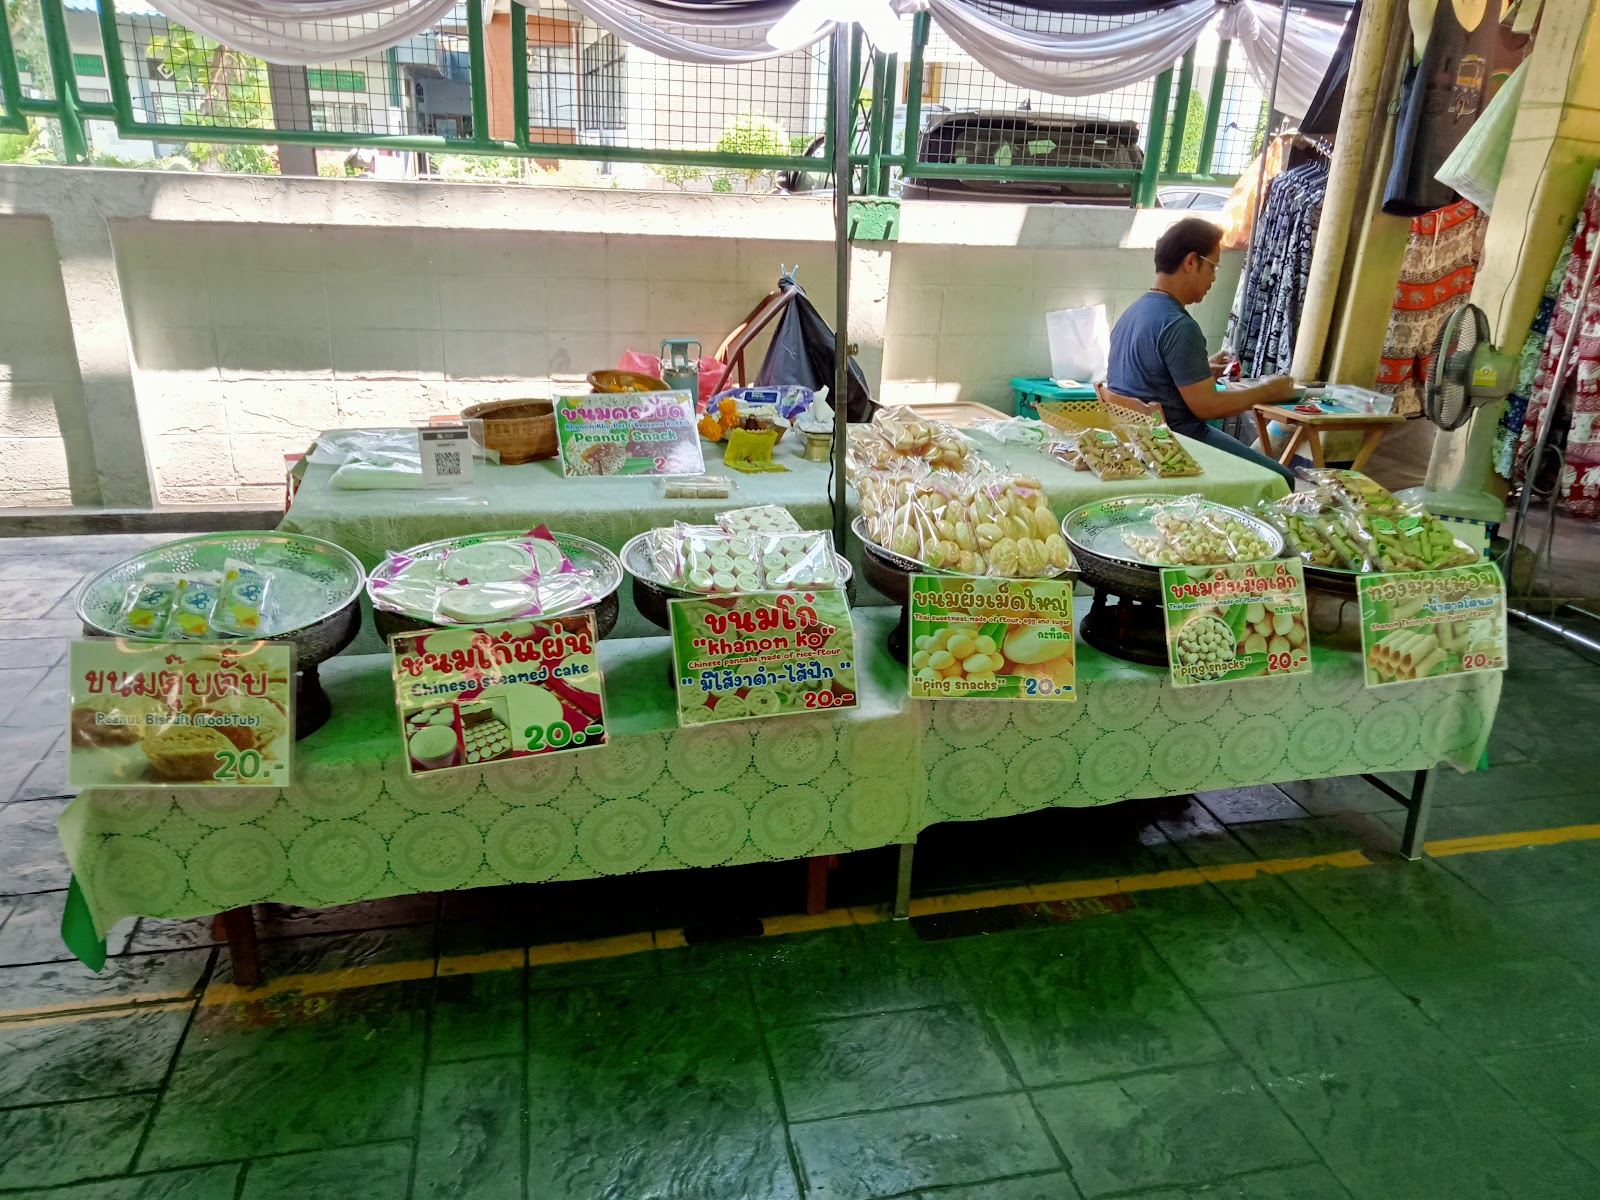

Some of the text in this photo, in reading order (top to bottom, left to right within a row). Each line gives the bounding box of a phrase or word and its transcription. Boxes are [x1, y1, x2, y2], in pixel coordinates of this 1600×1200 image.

[574, 429, 677, 443] Peanut Snack
[1171, 564, 1296, 599] ขนมผิงเม็ดเล็ก
[1366, 571, 1495, 602] ทองม้วนหอม
[914, 581, 1069, 618] ขนมผิงเม็ดใหญ่
[1184, 600, 1217, 609] sweetmeat
[704, 593, 819, 635] ขนมโก๋
[914, 613, 930, 621] Thai
[932, 615, 967, 623] sweetmeat
[970, 615, 986, 623] made
[999, 616, 1021, 625] flour,
[1024, 618, 1036, 626] egg
[1052, 619, 1071, 627] sugar
[1037, 627, 1070, 640] กะทิสด
[1371, 621, 1400, 631] Khanom
[1401, 618, 1424, 627] Thong
[401, 623, 593, 678] ขนมโก๋แผ่น
[688, 649, 841, 669] Chinese pancake made of rice-flour
[411, 662, 590, 697] Chinese steamed cake
[96, 712, 260, 727] Peanut Biscuit (ToobTub)
